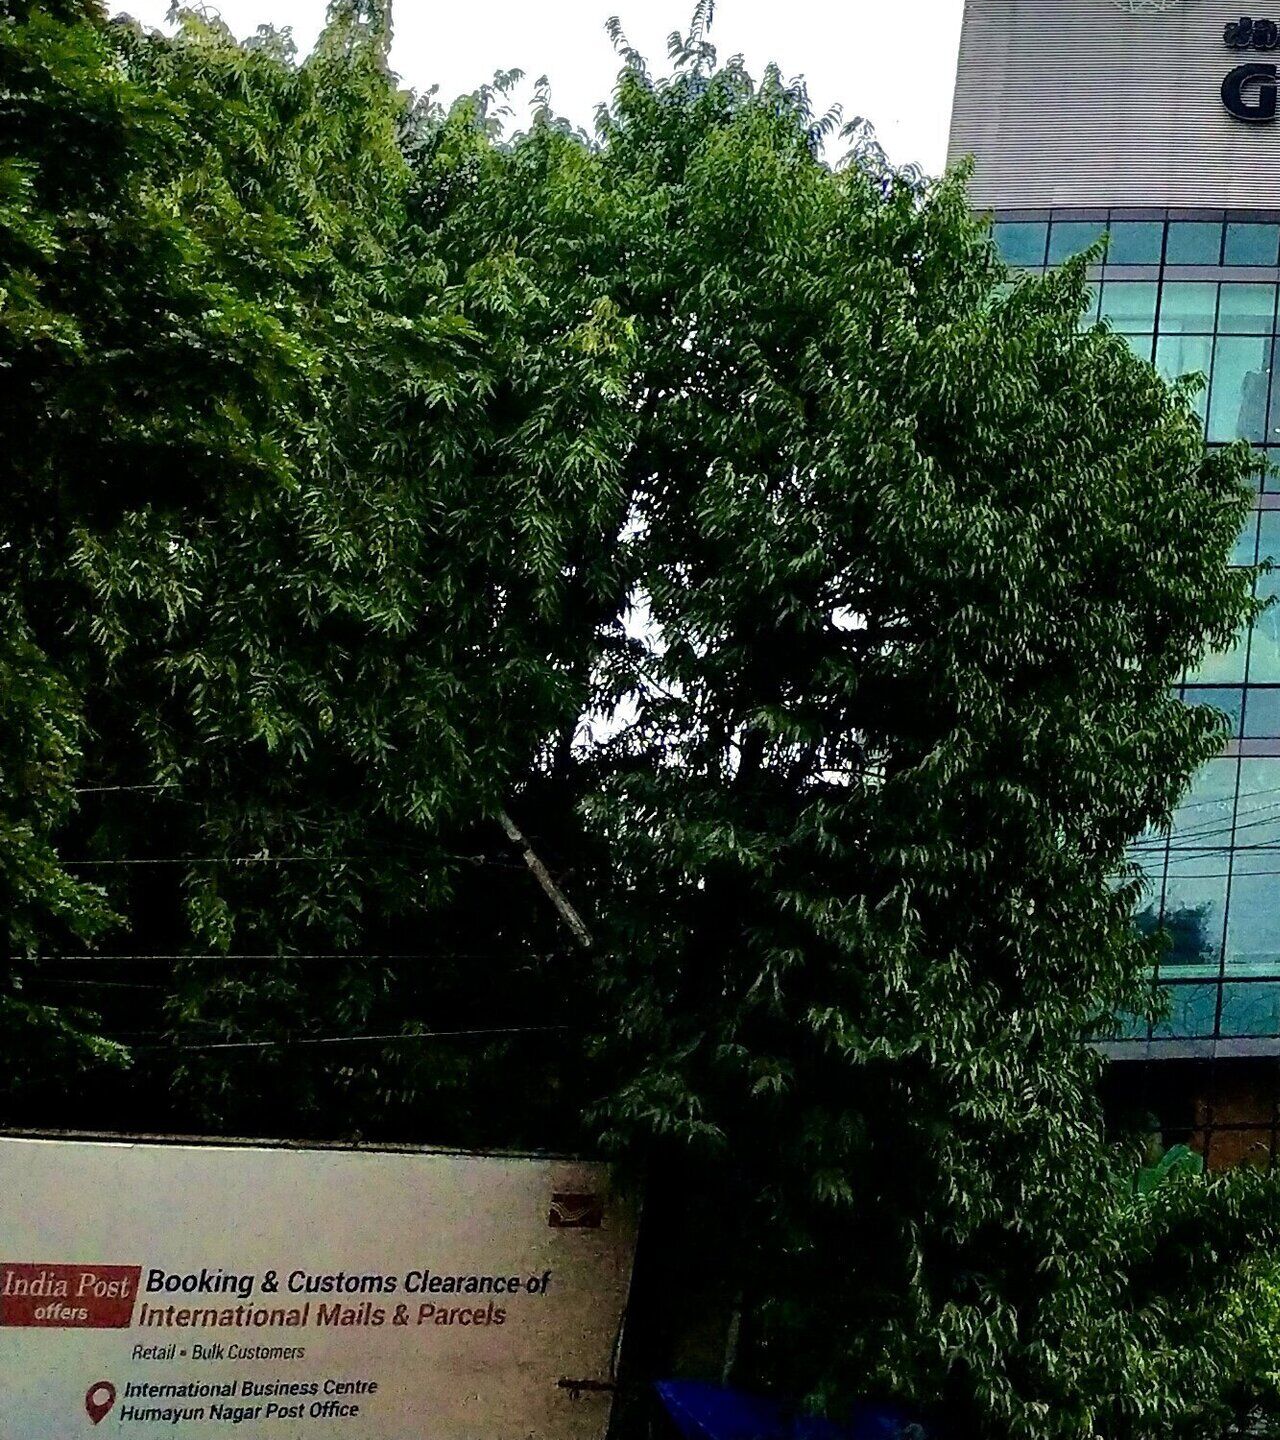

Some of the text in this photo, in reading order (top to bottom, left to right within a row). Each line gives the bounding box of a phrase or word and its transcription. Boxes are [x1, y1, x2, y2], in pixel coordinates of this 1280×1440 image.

[2, 1269, 130, 1299] India Post
[146, 1268, 552, 1299] Booking & Customs Clearance of
[34, 1303, 88, 1321] offers
[138, 1301, 507, 1328] International Mails & Parcels
[132, 1343, 305, 1360] Retail Bulk Customers
[124, 1379, 378, 1398] International Business Centre
[120, 1400, 360, 1424] Humayun Nagar Post Office
